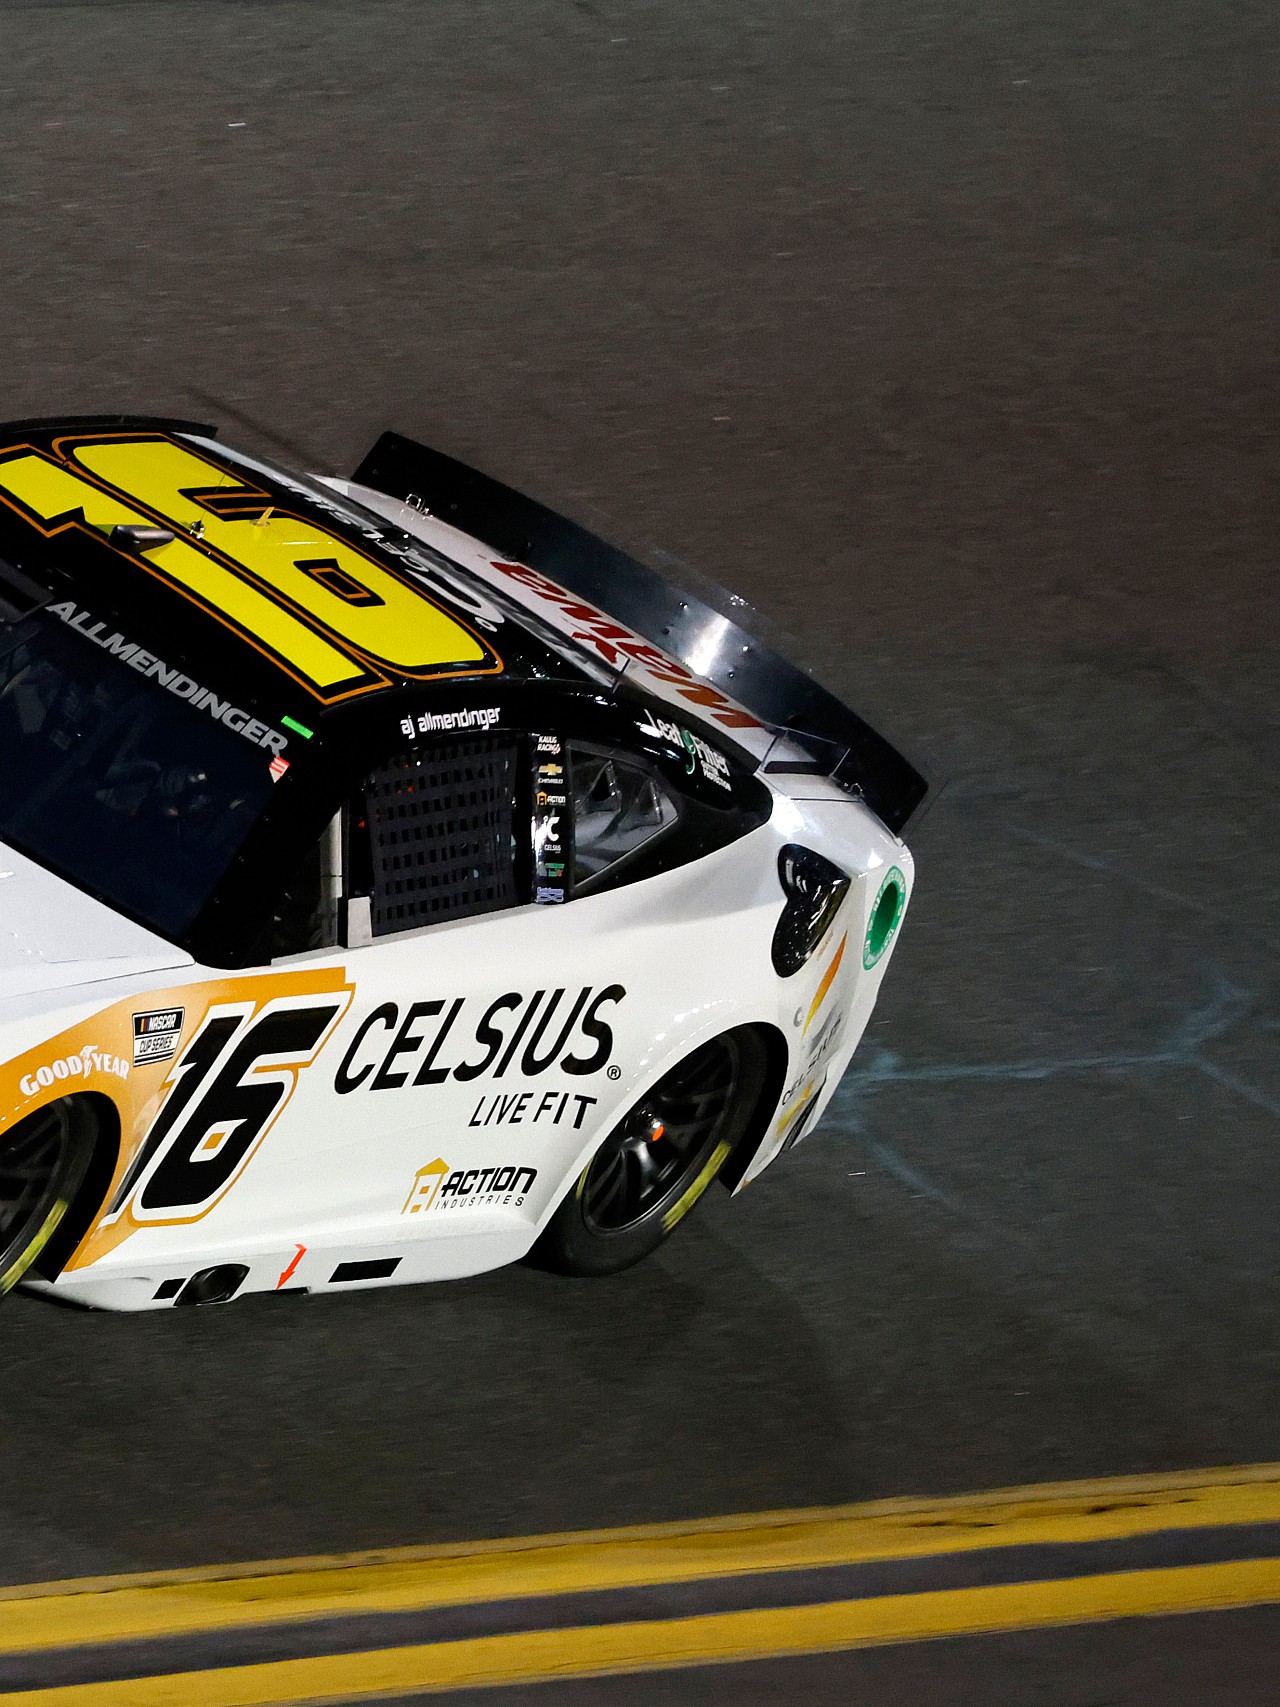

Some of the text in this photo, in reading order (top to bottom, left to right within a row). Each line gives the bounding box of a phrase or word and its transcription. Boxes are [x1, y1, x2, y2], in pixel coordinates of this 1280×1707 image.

[45, 602, 288, 756] ALLMENDINGER
[400, 708, 501, 739] aj allmendinger
[148, 1014, 177, 1031] NASCAR
[334, 984, 627, 1095] CELSIUS
[140, 1036, 173, 1053] CUP SERIES
[20, 1050, 130, 1096] GOODYEAR
[104, 998, 348, 1218] 16
[468, 1091, 598, 1129] LIVE FIT
[441, 1166, 537, 1198] ACTION
[435, 1195, 524, 1210] INDUSTRIES
